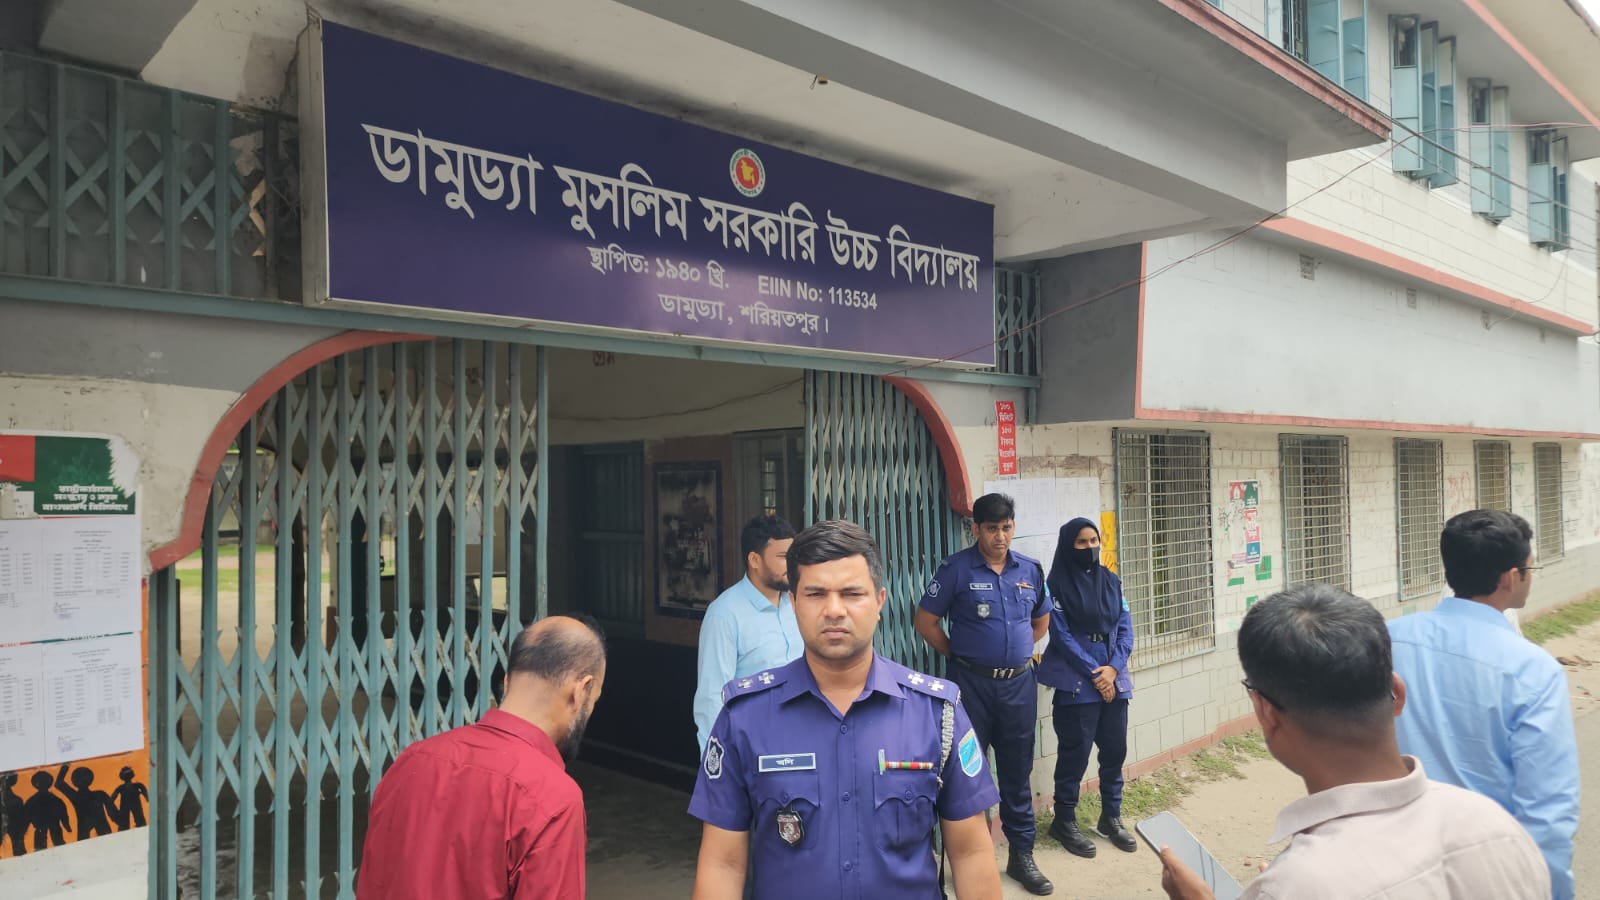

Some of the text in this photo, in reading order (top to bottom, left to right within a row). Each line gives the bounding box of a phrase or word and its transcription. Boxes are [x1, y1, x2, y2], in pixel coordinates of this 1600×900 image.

[361, 123, 544, 219] ডামুড্যা
[553, 163, 692, 240] মুসলিম
[698, 197, 819, 264] সরকারি
[825, 209, 881, 272] উচ্চ
[886, 224, 980, 292] বিদ্যালয়
[655, 257, 701, 282] ১৯৪০
[758, 275, 878, 310] EIIN No: 113534
